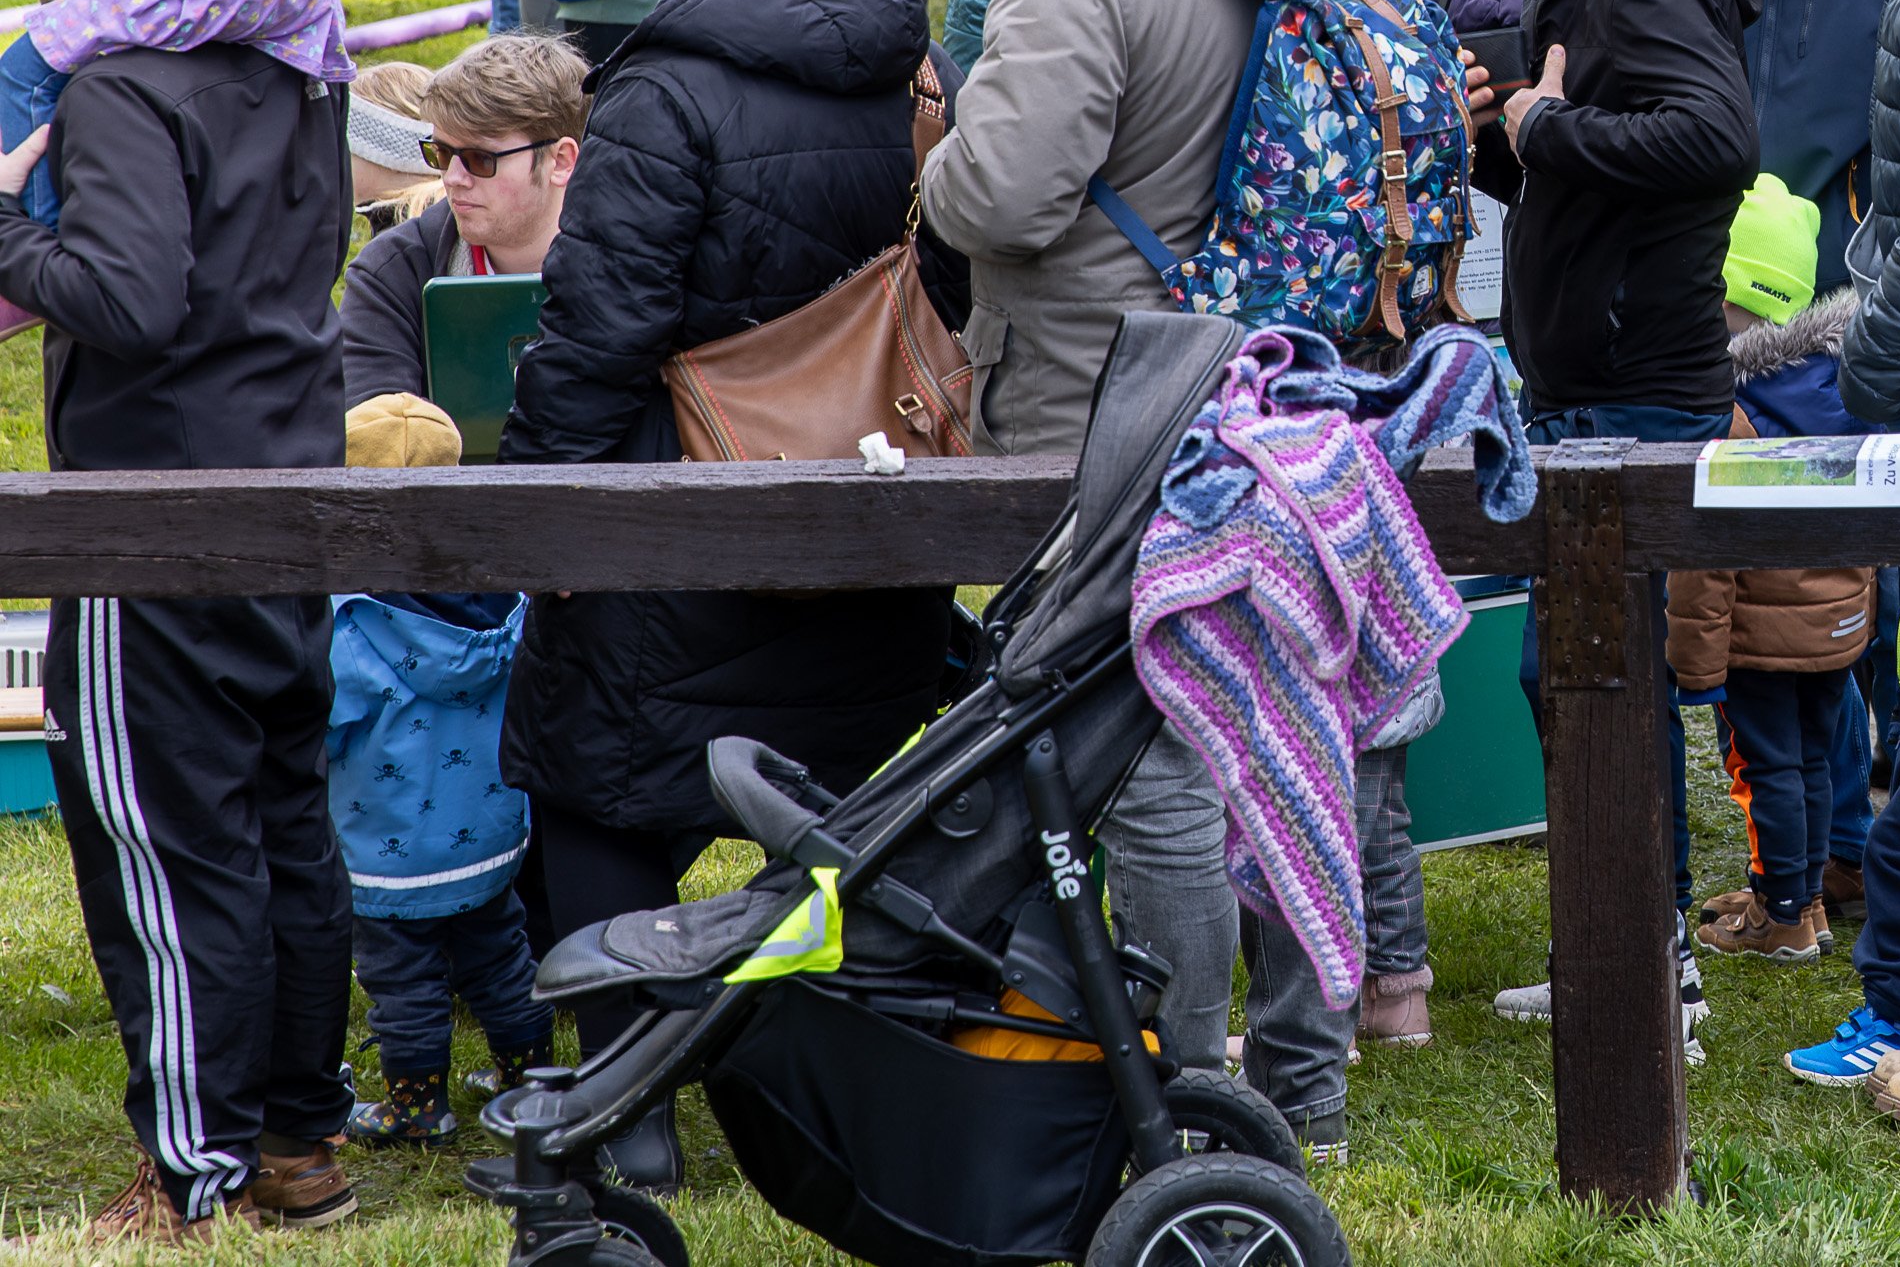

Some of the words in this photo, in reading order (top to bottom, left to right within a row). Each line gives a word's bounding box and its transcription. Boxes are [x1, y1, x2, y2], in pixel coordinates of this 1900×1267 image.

[1751, 281, 1791, 303] KOMATSU
[1884, 470, 1896, 486] Zu
[1041, 830, 1087, 900] Joie
